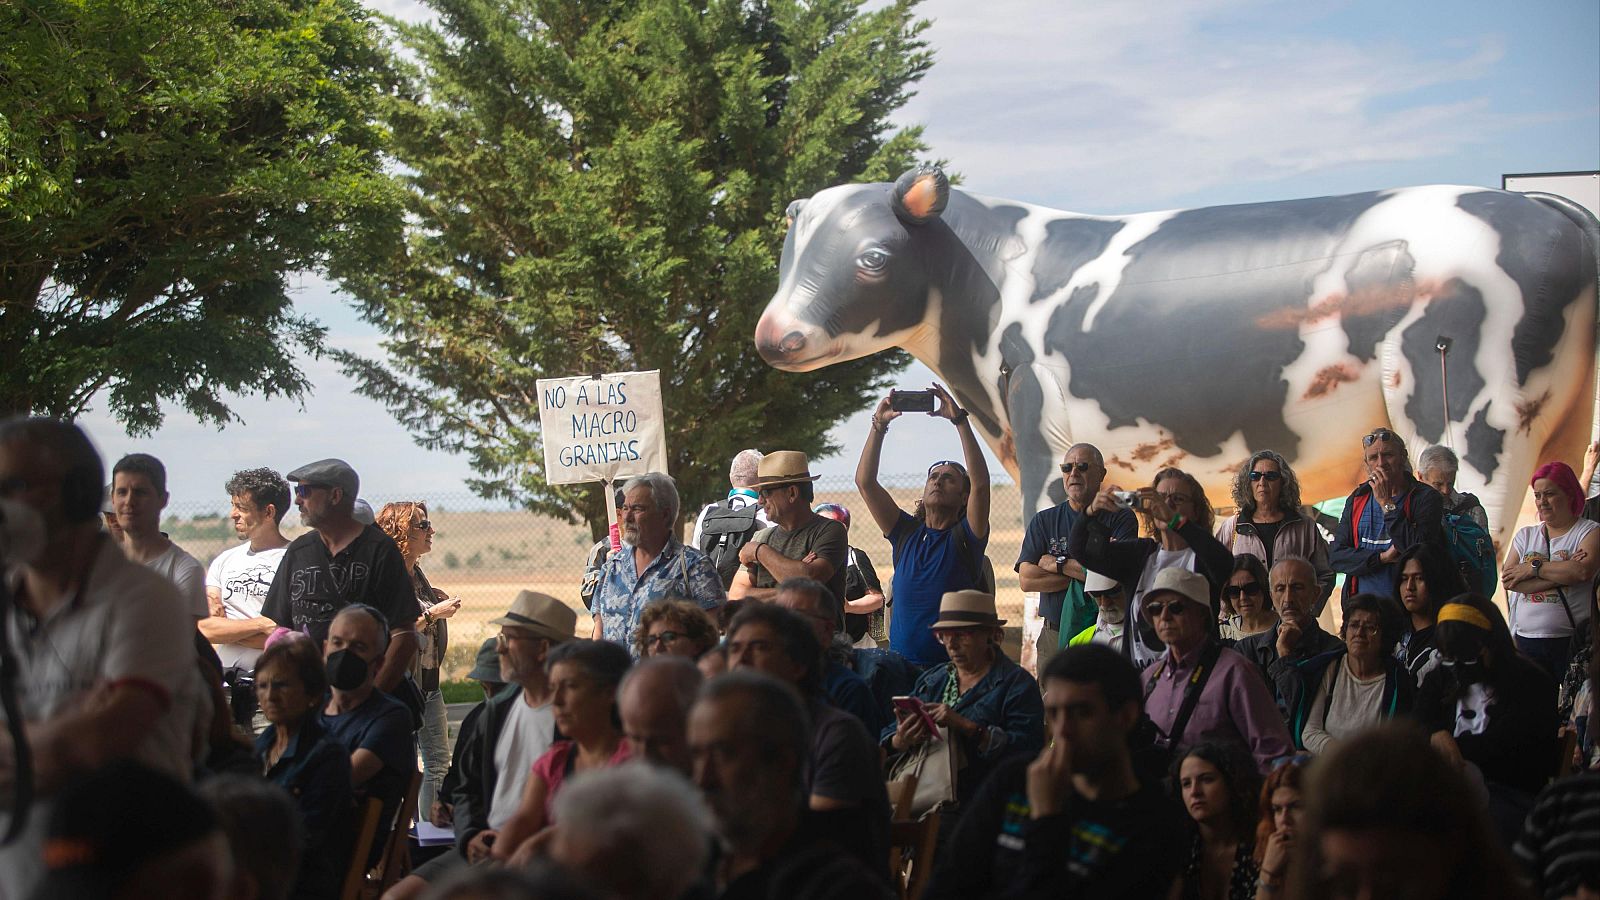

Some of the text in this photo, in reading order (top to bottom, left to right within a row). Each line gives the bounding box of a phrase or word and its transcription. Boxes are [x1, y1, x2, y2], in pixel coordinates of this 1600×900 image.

[545, 382, 627, 410] NO A LAS
[572, 410, 637, 438] MACRO
[559, 440, 642, 467] GRANJAS.
[291, 562, 369, 601] STOP
